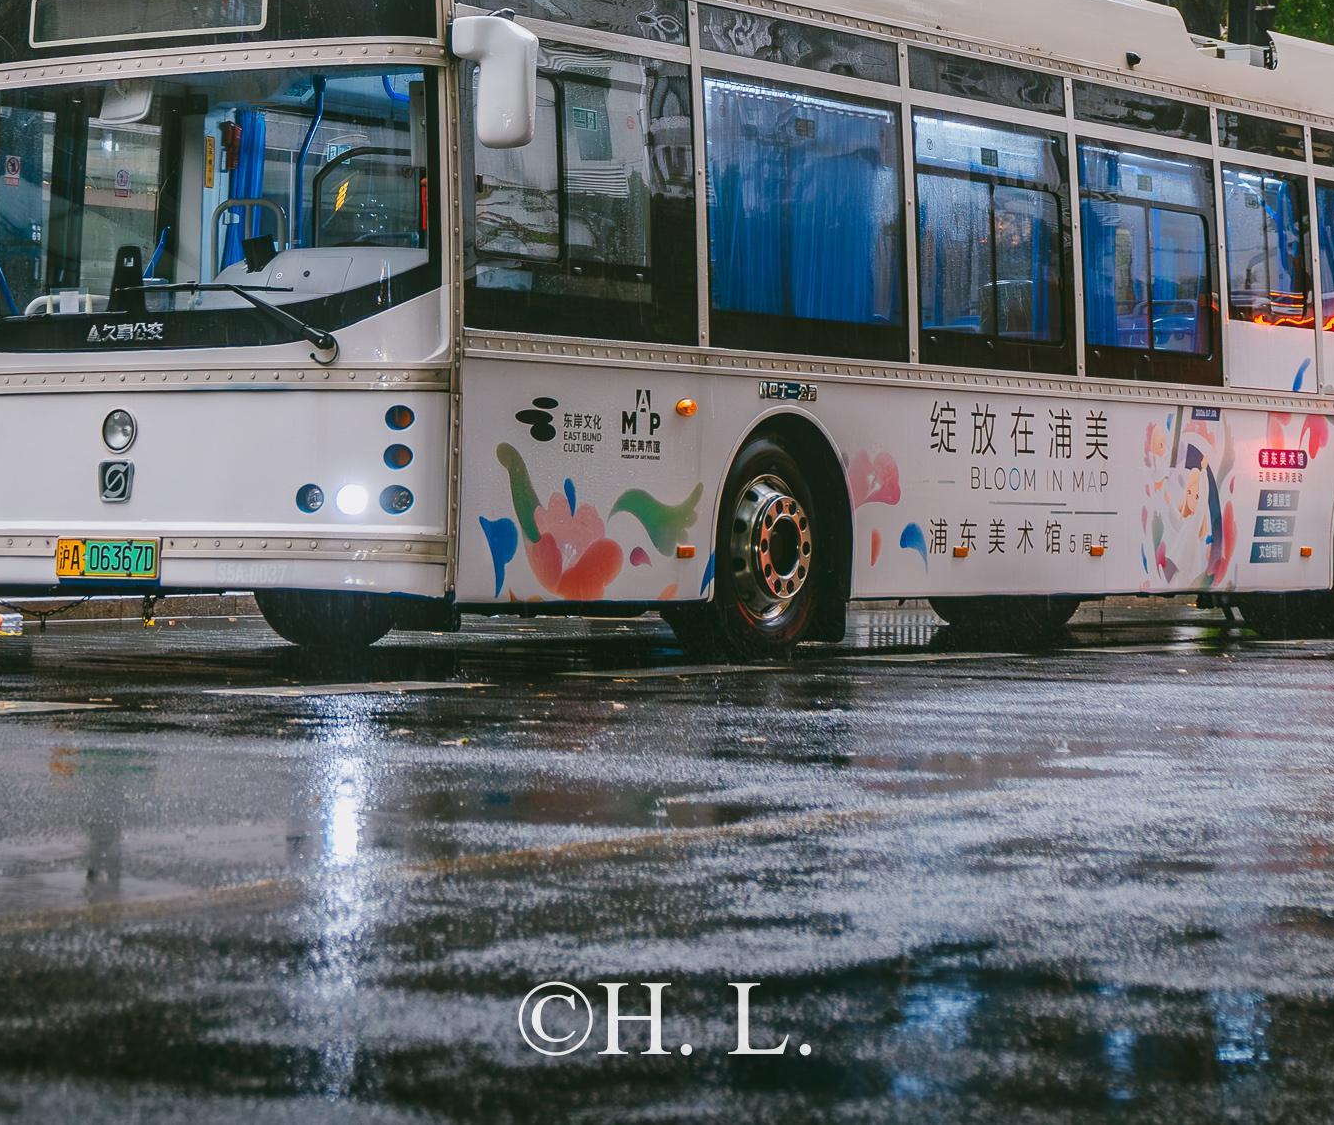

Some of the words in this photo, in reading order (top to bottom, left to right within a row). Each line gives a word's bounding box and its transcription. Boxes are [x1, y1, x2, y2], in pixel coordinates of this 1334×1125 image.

[563, 412, 602, 430] 东岸文化
[563, 431, 581, 441] EAST
[582, 432, 602, 442] BUND
[929, 400, 1110, 461] 绽放在浦美
[563, 443, 595, 453] CULTURE
[620, 439, 661, 453] 浦东美术馆
[970, 466, 1036, 491] BLOOM
[1046, 469, 1063, 492] IN
[1072, 470, 1109, 493] MAP
[929, 517, 1063, 555] 浦东美术馆
